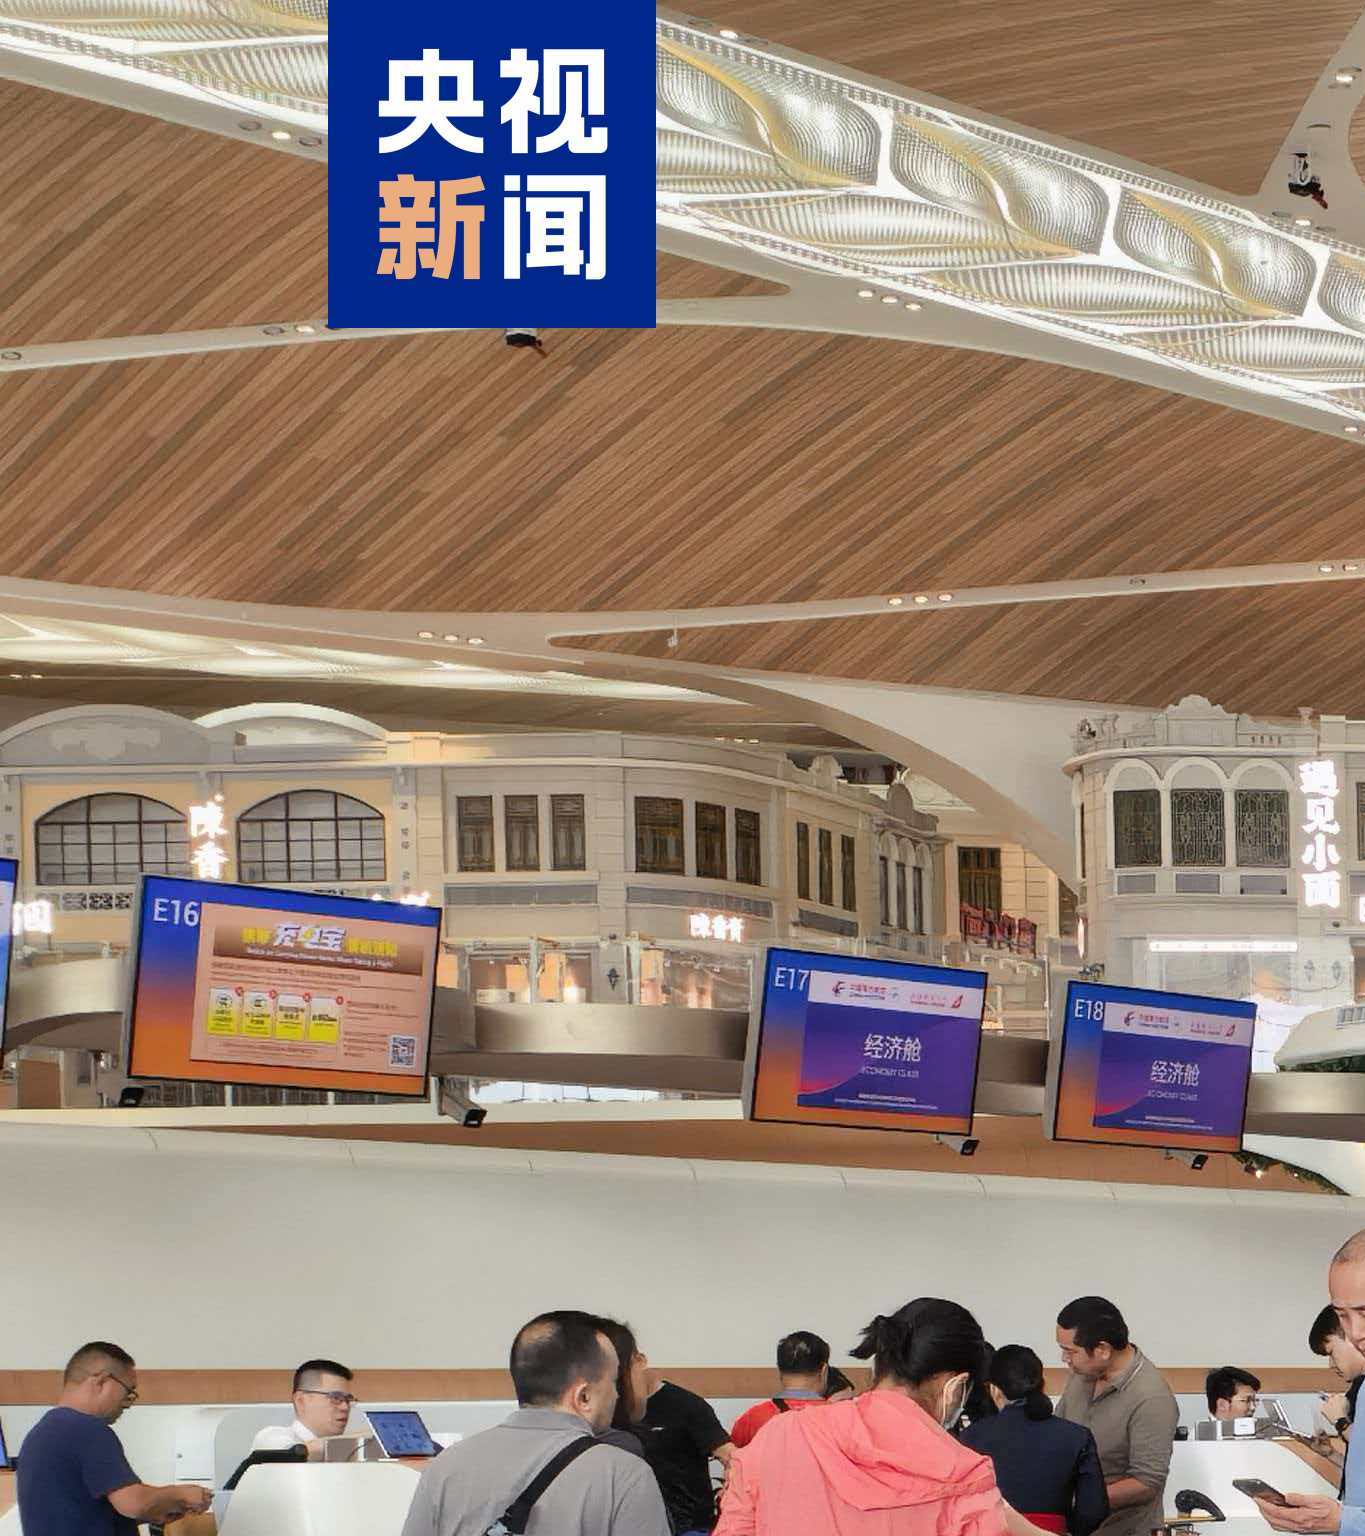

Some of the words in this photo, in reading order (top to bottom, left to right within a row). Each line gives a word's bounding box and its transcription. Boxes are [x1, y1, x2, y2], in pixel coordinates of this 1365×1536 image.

[153, 898, 199, 927] E16
[774, 966, 809, 991] E17
[1074, 999, 1104, 1021] E18
[863, 1033, 921, 1062] 经济舱
[1150, 1060, 1200, 1087] 经济舱
